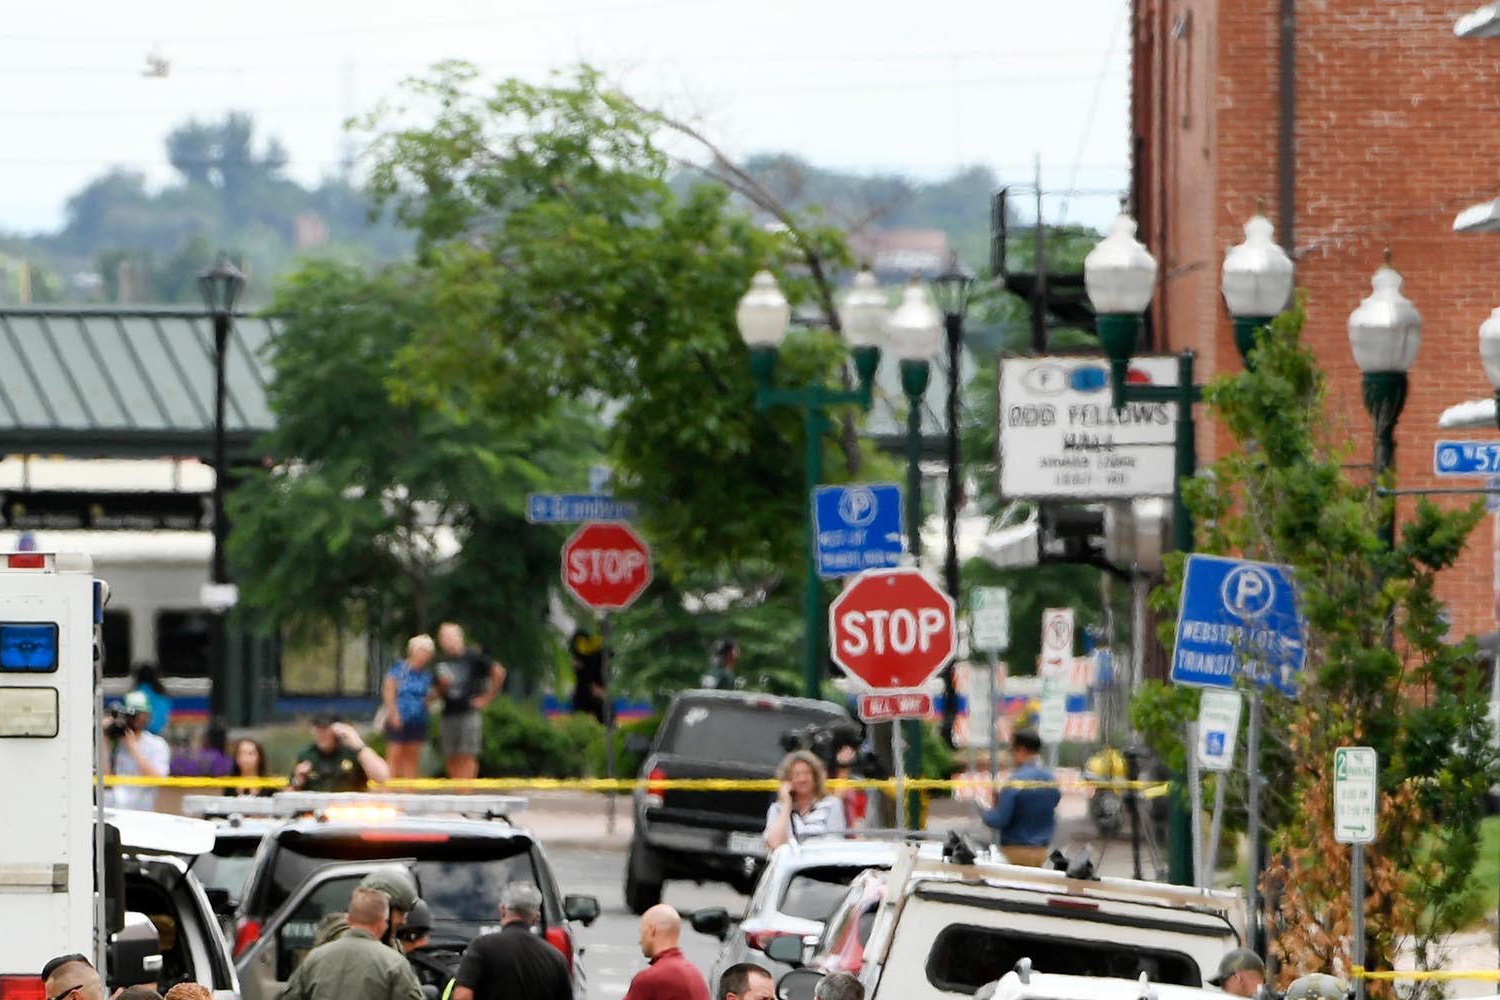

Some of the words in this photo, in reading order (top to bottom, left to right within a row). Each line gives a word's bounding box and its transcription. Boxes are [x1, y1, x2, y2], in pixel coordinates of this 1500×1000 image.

[1009, 404, 1057, 427] ODD
[1068, 403, 1170, 428] FELLOWS
[570, 549, 645, 584] STOP
[842, 607, 946, 656] STOP
[1337, 752, 1348, 777] 2
